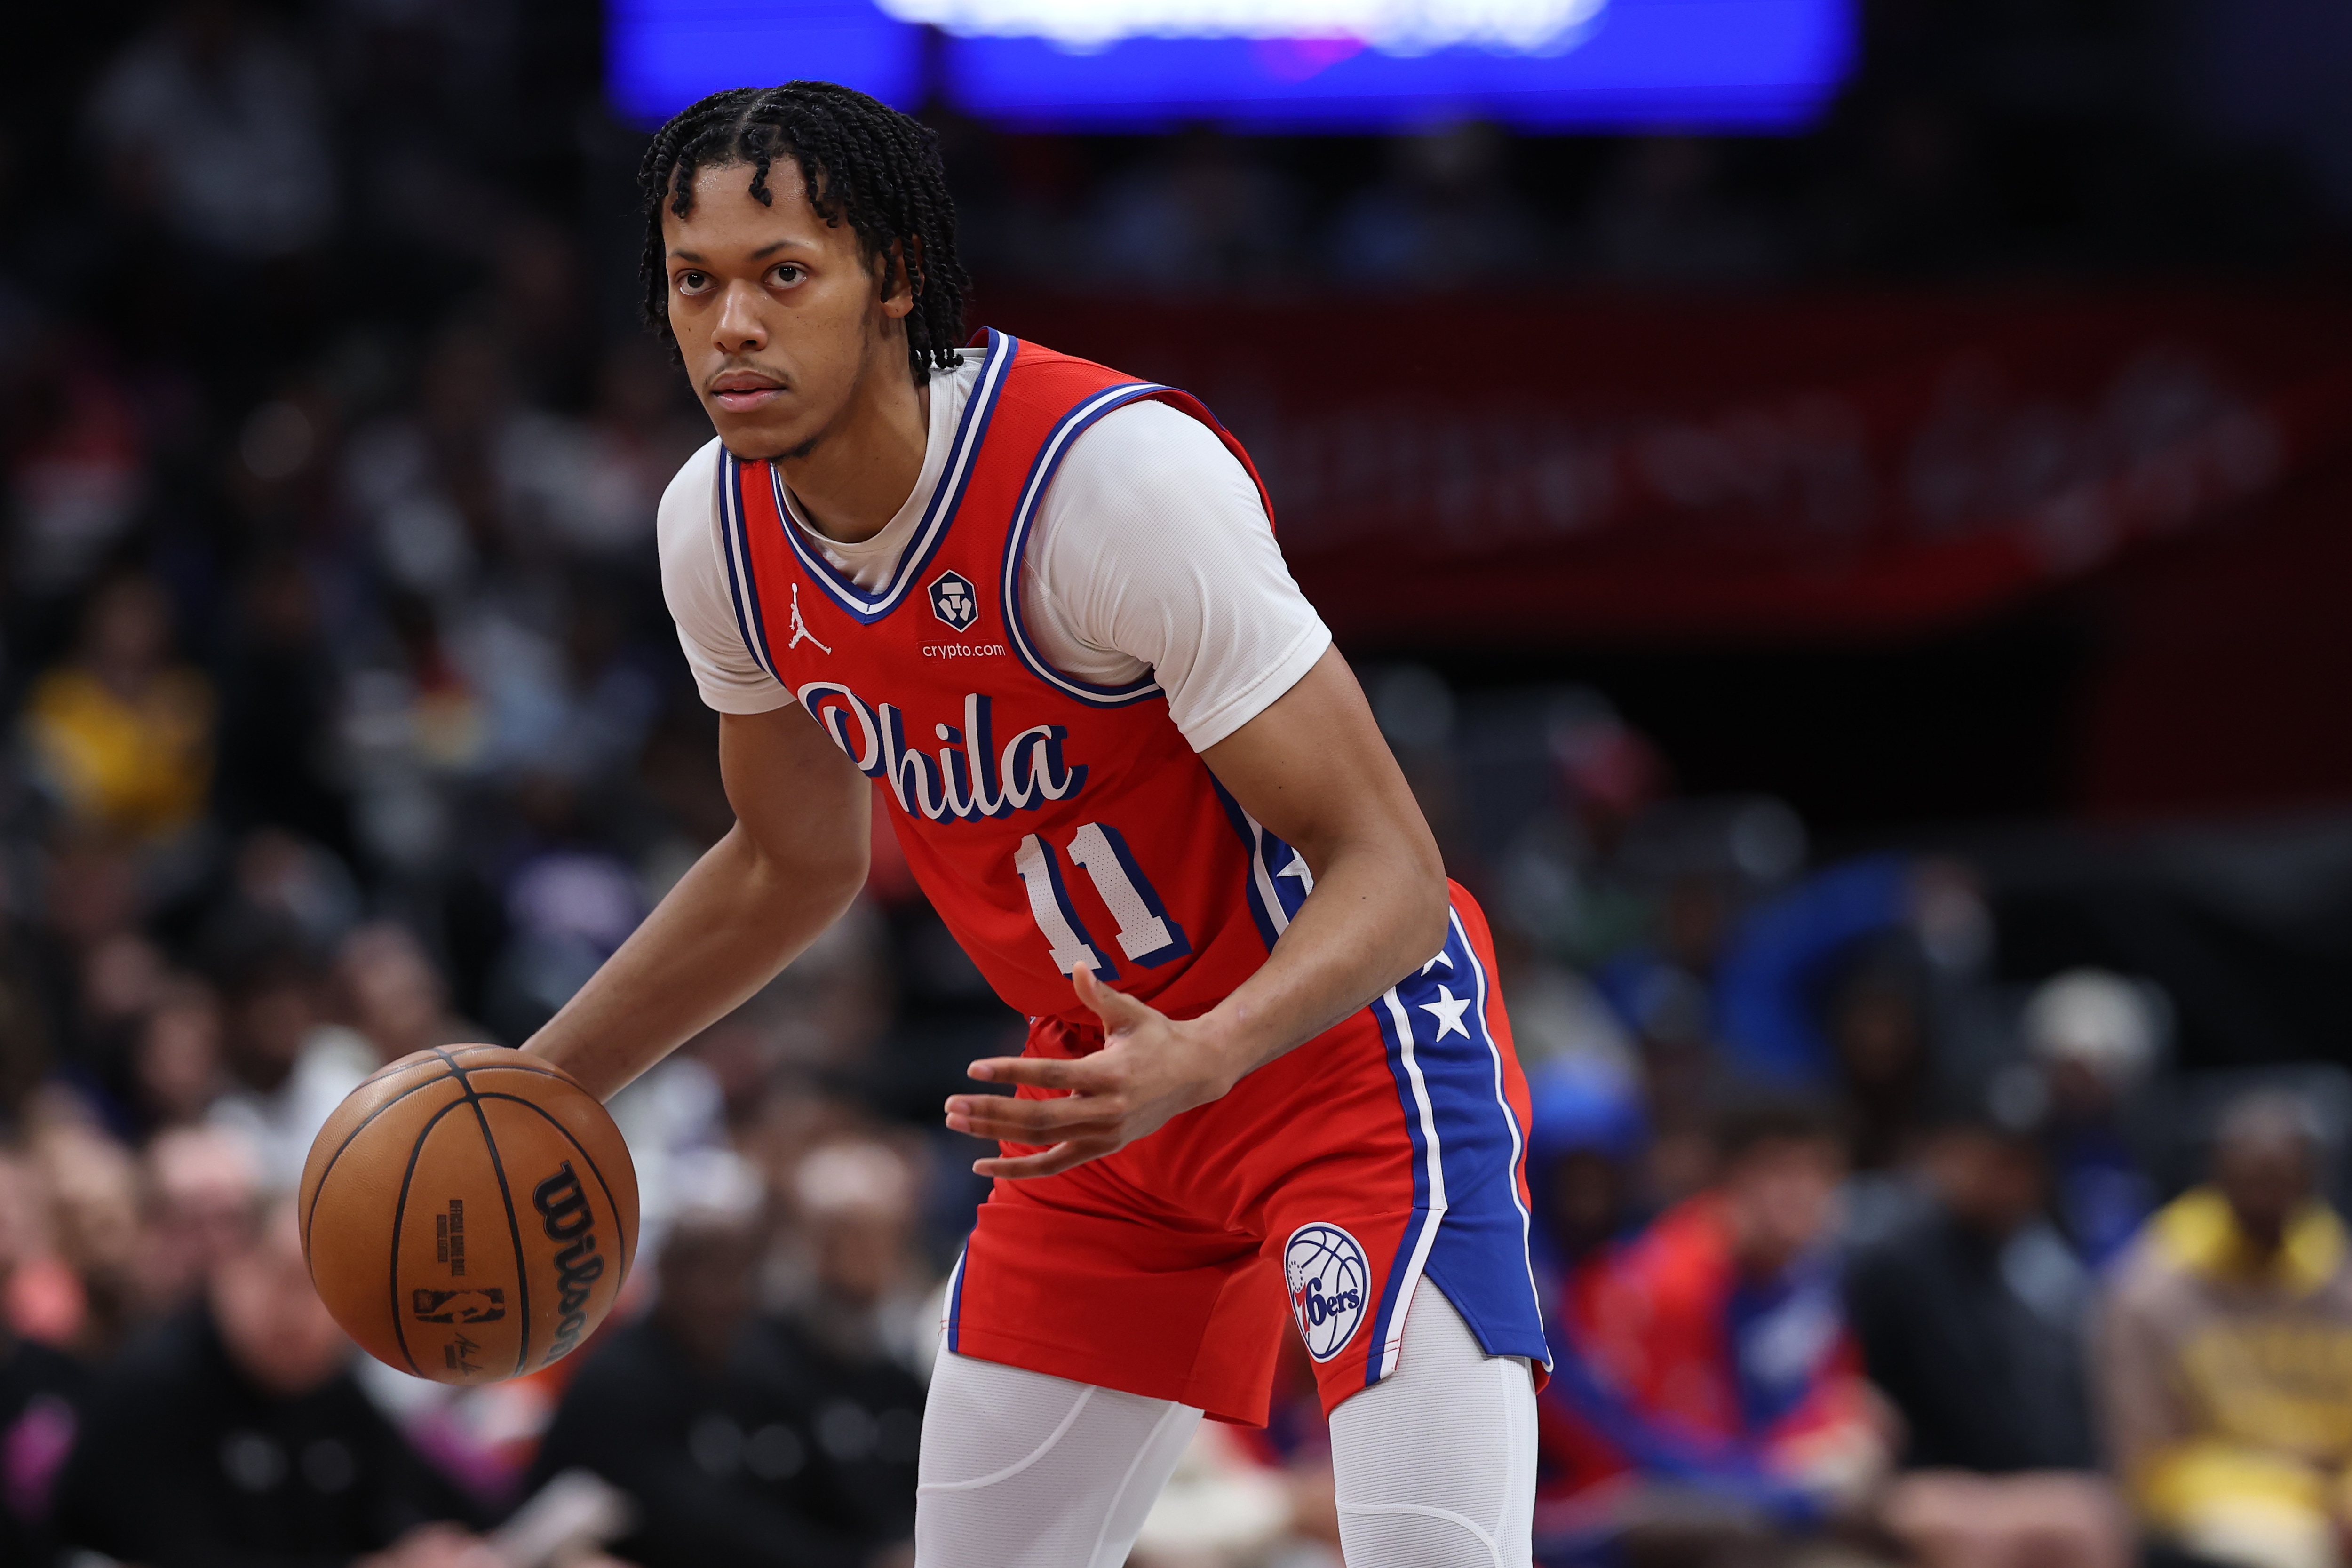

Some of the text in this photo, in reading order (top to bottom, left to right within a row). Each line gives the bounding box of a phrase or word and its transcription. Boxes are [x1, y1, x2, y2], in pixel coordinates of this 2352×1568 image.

[922, 643, 1006, 659] crypto.com
[797, 681, 1089, 824] Phila
[1013, 821, 1193, 981] 11
[533, 1160, 604, 1363] Wilson
[1292, 1276, 1359, 1333] 76ers
